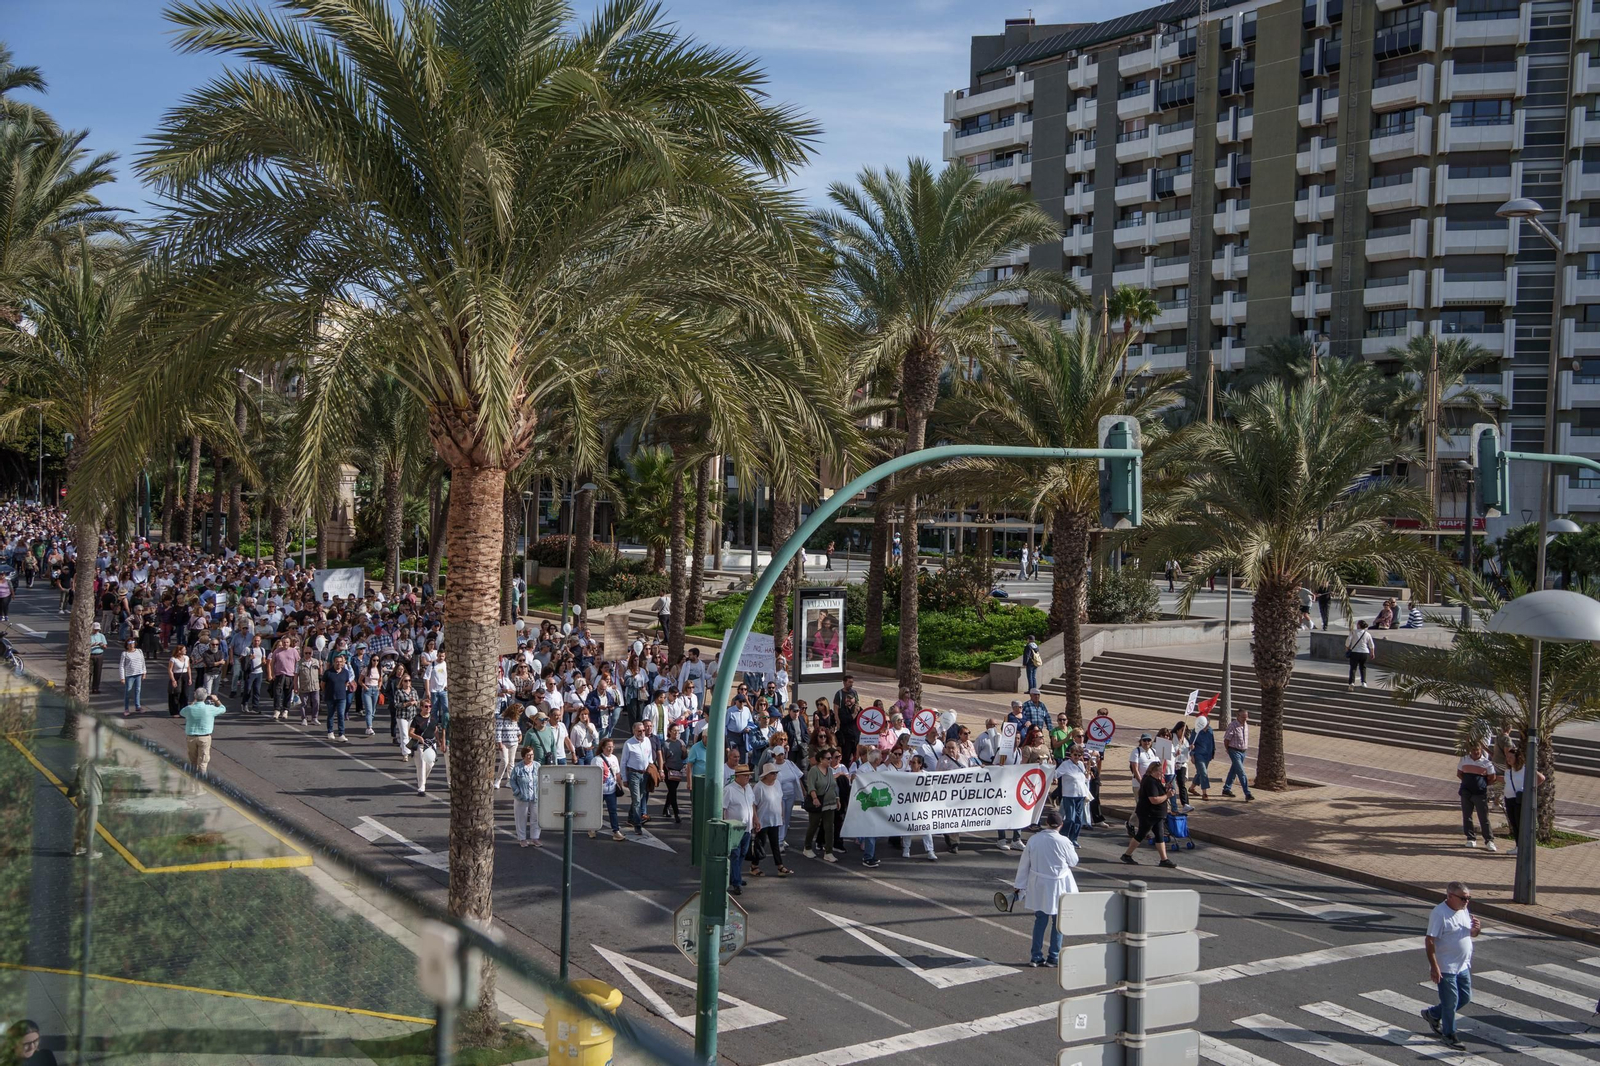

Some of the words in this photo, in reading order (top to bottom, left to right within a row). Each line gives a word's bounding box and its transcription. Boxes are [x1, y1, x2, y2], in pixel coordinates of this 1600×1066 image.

[806, 600, 840, 608] VALENTINO
[915, 773, 974, 786] DEFIENDE
[975, 771, 992, 783] LA
[897, 790, 948, 805] SANIDAD
[951, 786, 1007, 801] PÚBLICA:
[888, 812, 902, 823] NO
[904, 812, 910, 821] A
[911, 810, 929, 820] LAS
[931, 805, 1013, 819] PRIVATIZACIONES
[906, 823, 931, 832] Marea
[932, 821, 959, 830] Blanca
[960, 817, 991, 828] Almería
